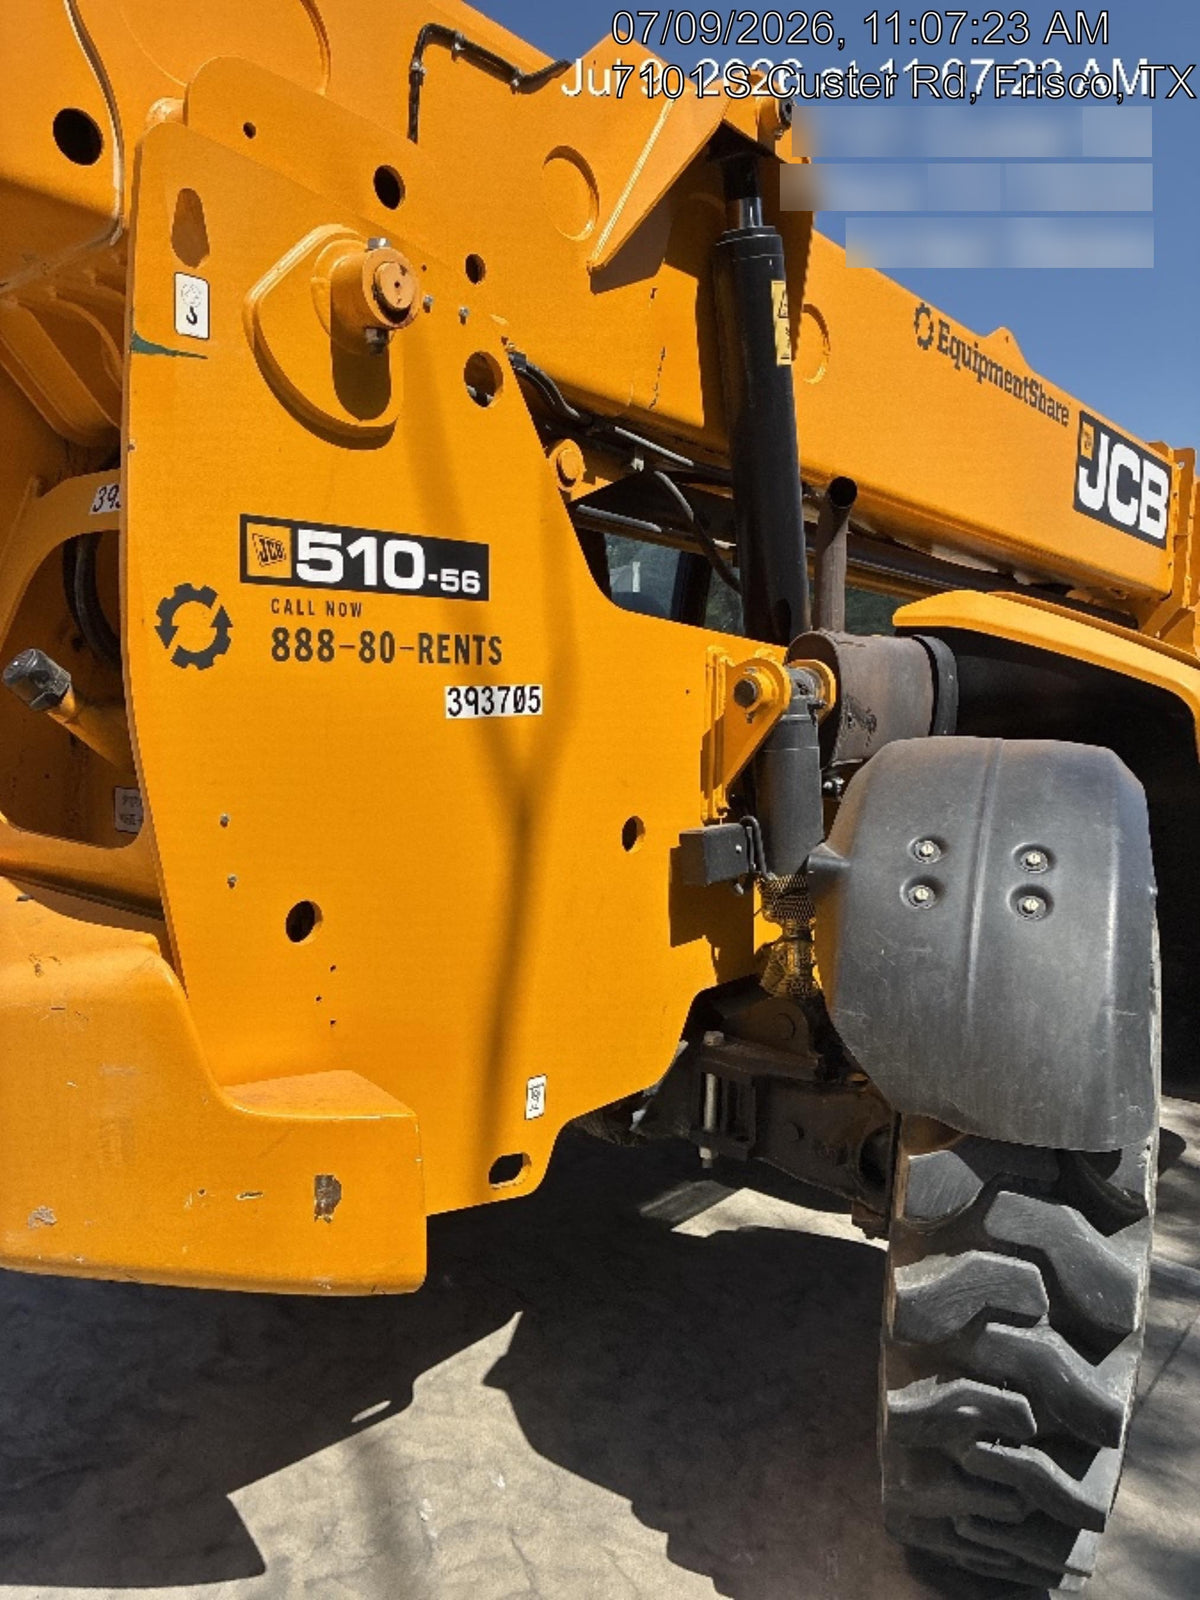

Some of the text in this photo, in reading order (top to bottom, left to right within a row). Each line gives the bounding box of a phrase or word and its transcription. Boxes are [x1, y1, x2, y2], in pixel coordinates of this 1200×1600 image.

[937, 318, 1069, 427] EquipmentShare
[92, 484, 121, 512] 39
[1078, 432, 1169, 539] JCB
[258, 528, 481, 594] JCB 510-56
[271, 598, 362, 617] CALL NOW
[271, 627, 502, 665] 888-80-RENTS
[447, 686, 541, 716] 393705
